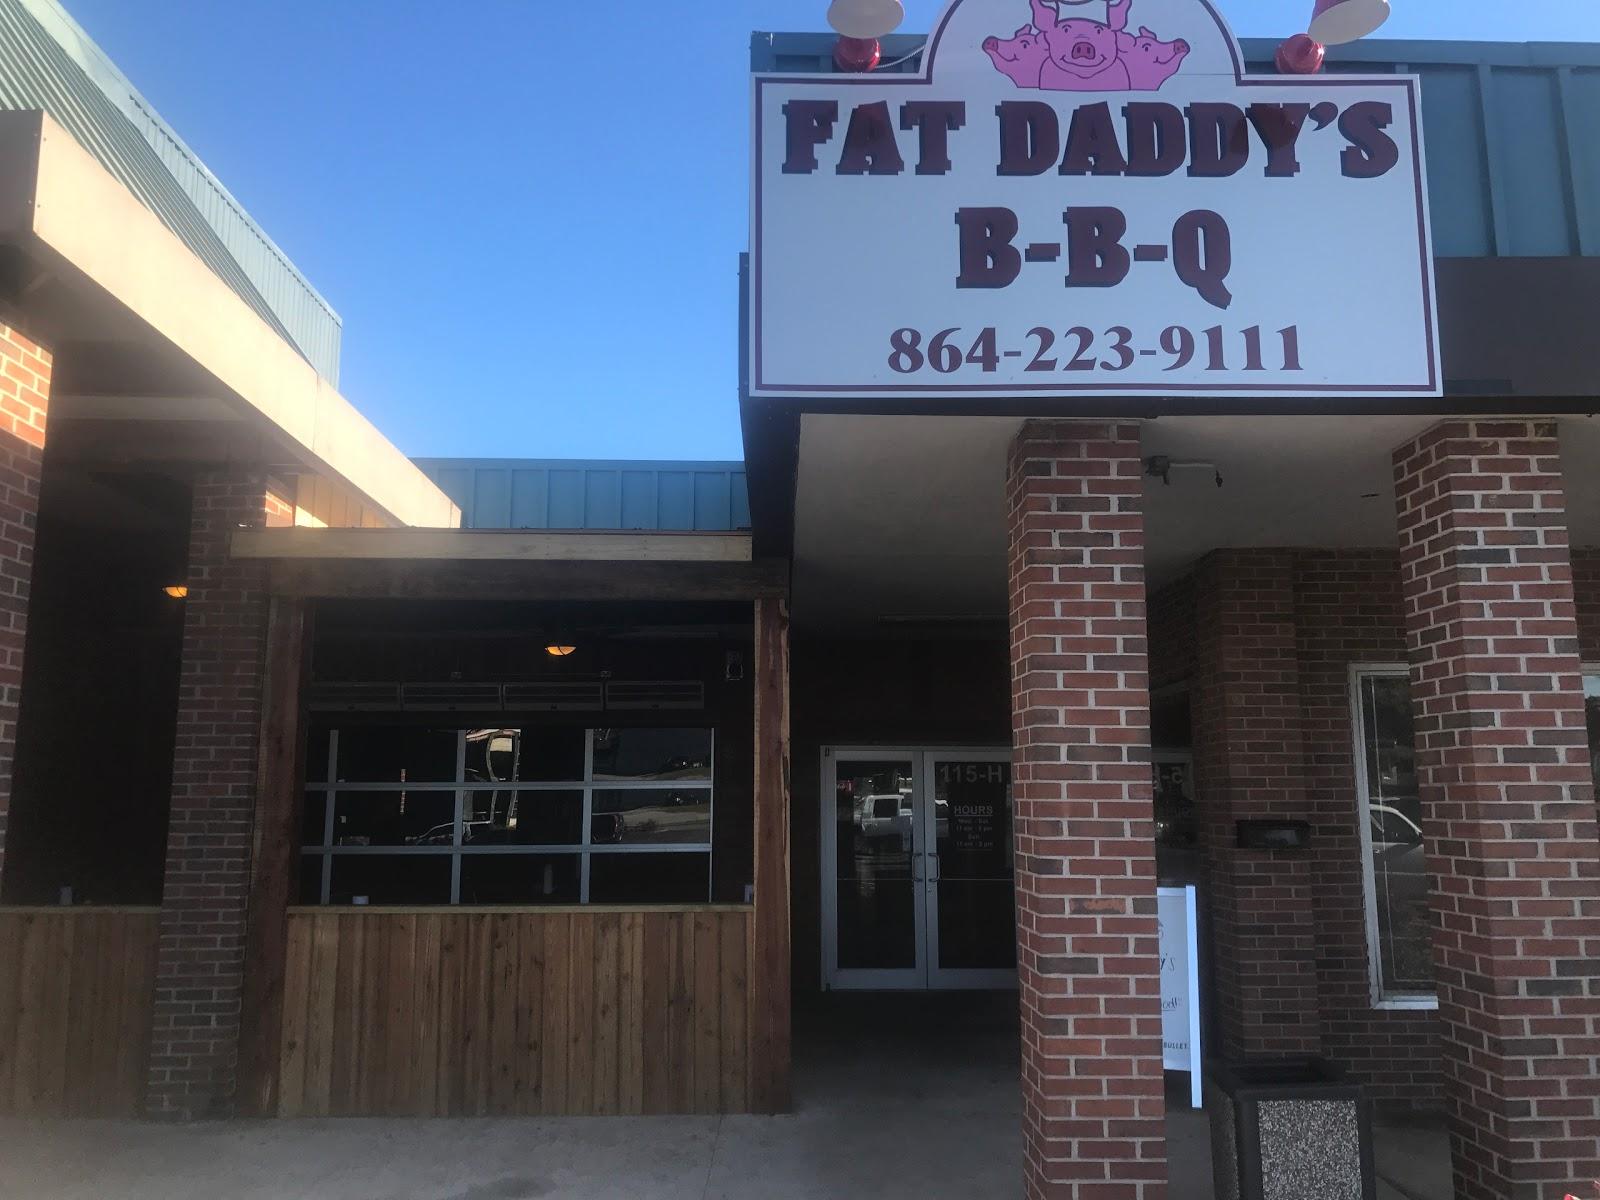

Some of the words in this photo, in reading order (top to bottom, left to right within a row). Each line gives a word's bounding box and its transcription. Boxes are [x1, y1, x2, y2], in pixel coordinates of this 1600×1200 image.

[782, 99, 967, 176] FAT
[994, 100, 1398, 178] DADDY'S
[955, 207, 1233, 310] B-B-Q
[888, 325, 1303, 374] 864-223-9111
[940, 764, 1002, 783] 115-H
[954, 805, 993, 815] HOURS
